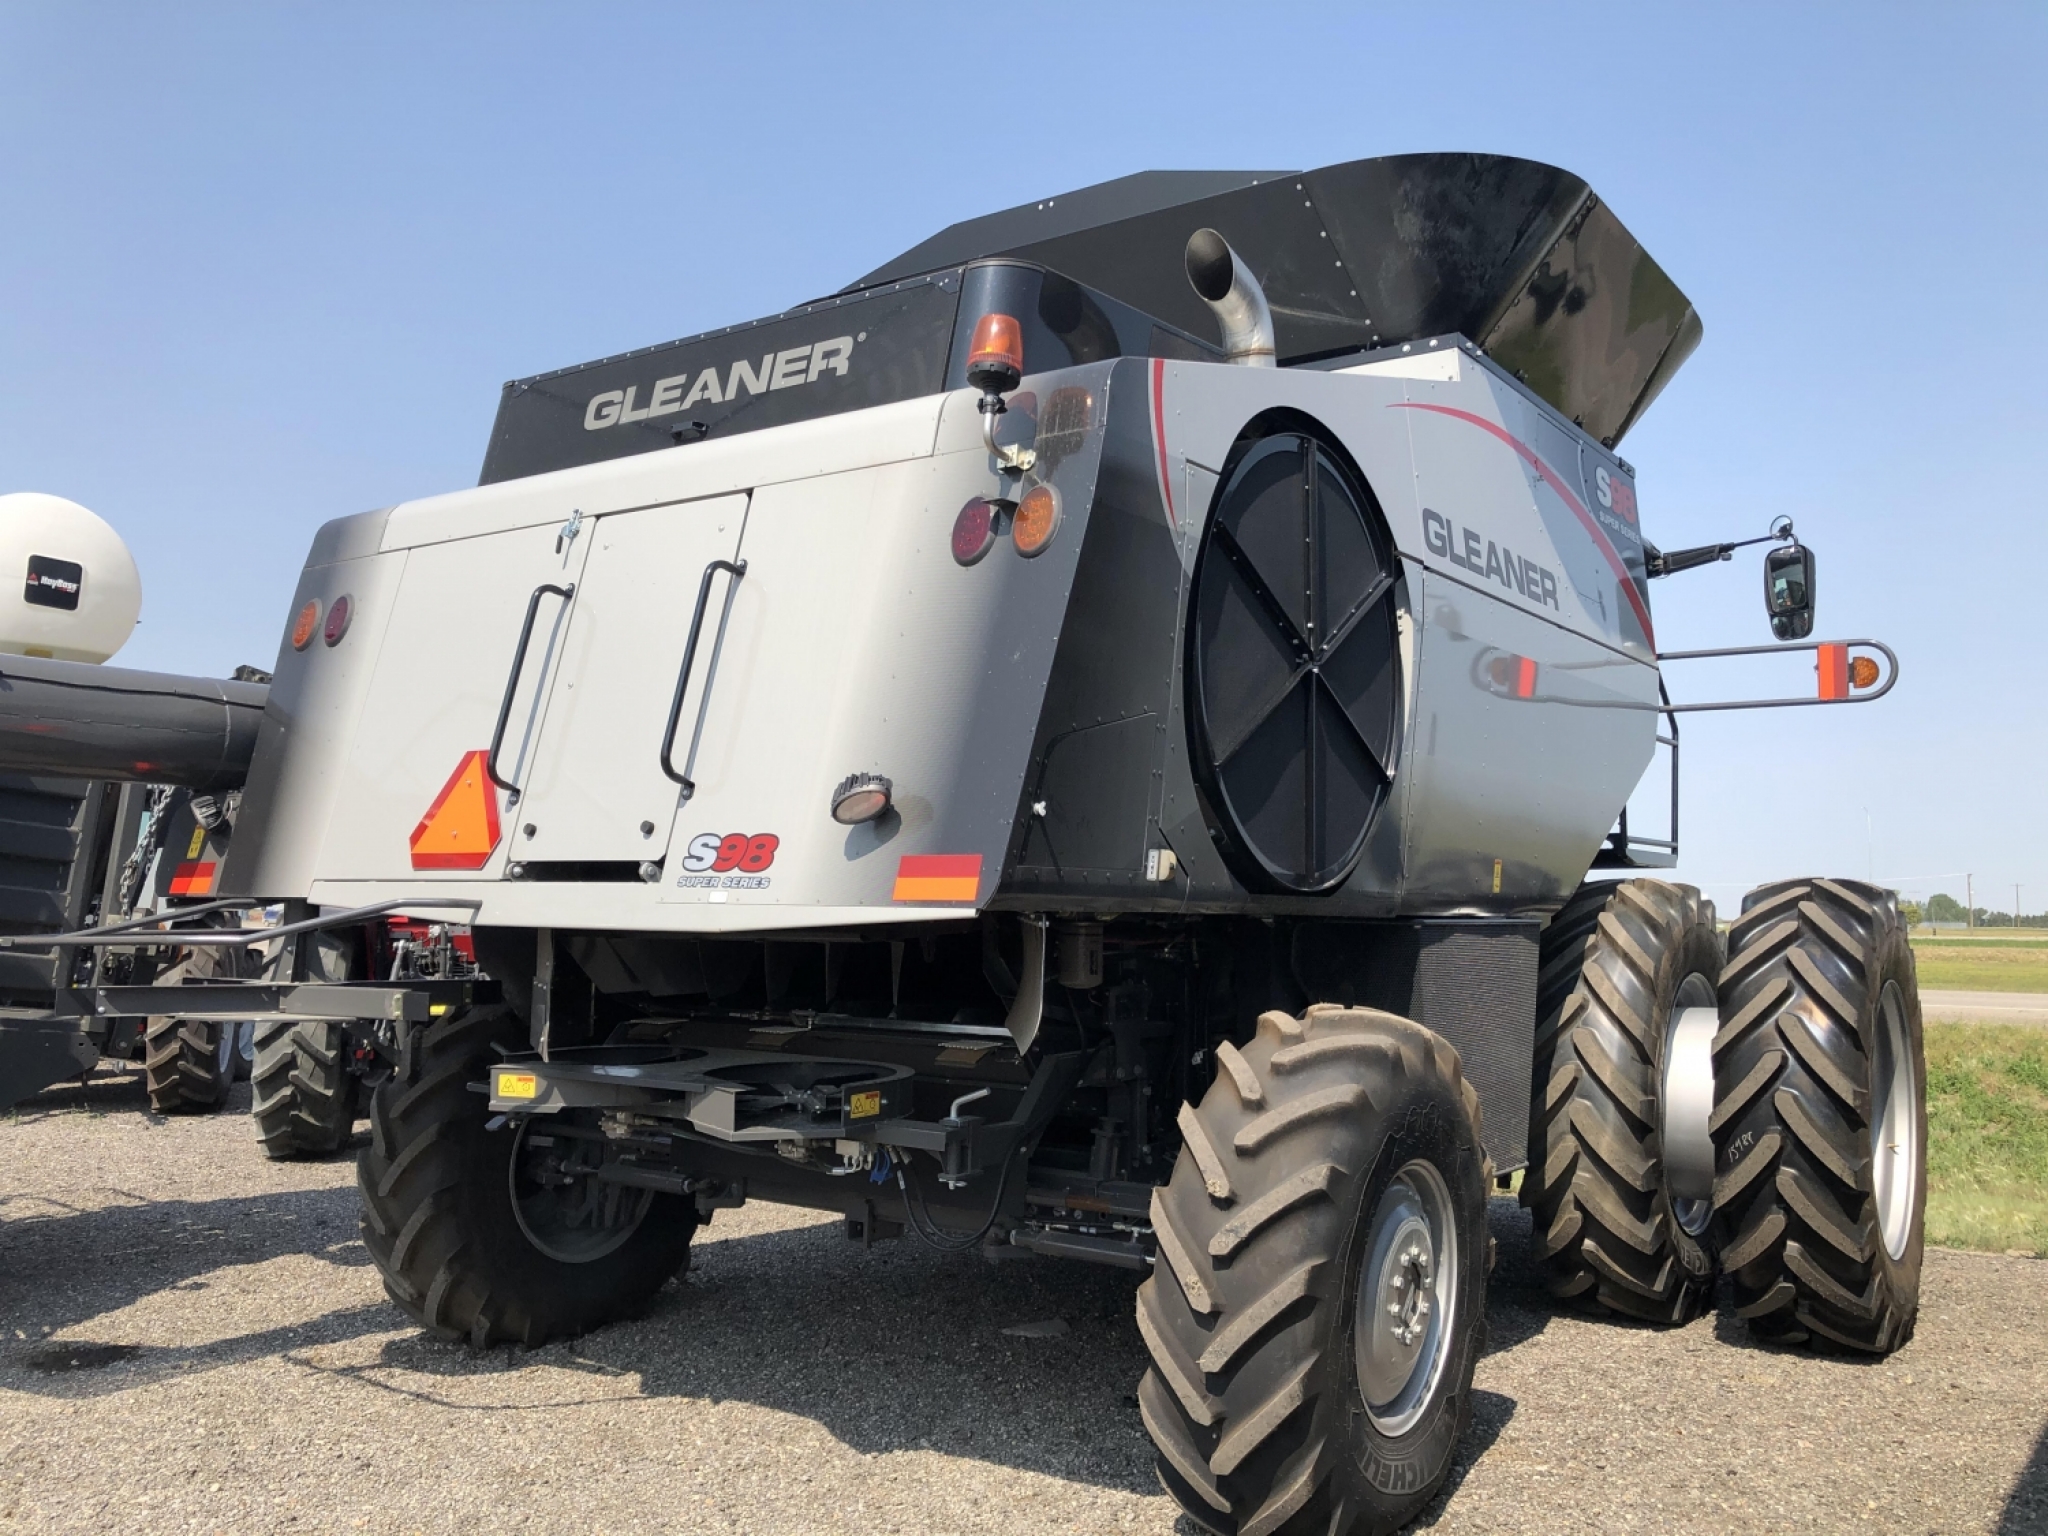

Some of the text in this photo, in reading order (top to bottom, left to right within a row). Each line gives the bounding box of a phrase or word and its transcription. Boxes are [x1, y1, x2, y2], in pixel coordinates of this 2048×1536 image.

[583, 335, 853, 431] GLEANER
[1594, 465, 1638, 525] S98
[1422, 507, 1560, 612] GLEANER
[677, 875, 771, 890] SUPER SERIES
[682, 832, 780, 873] S98
